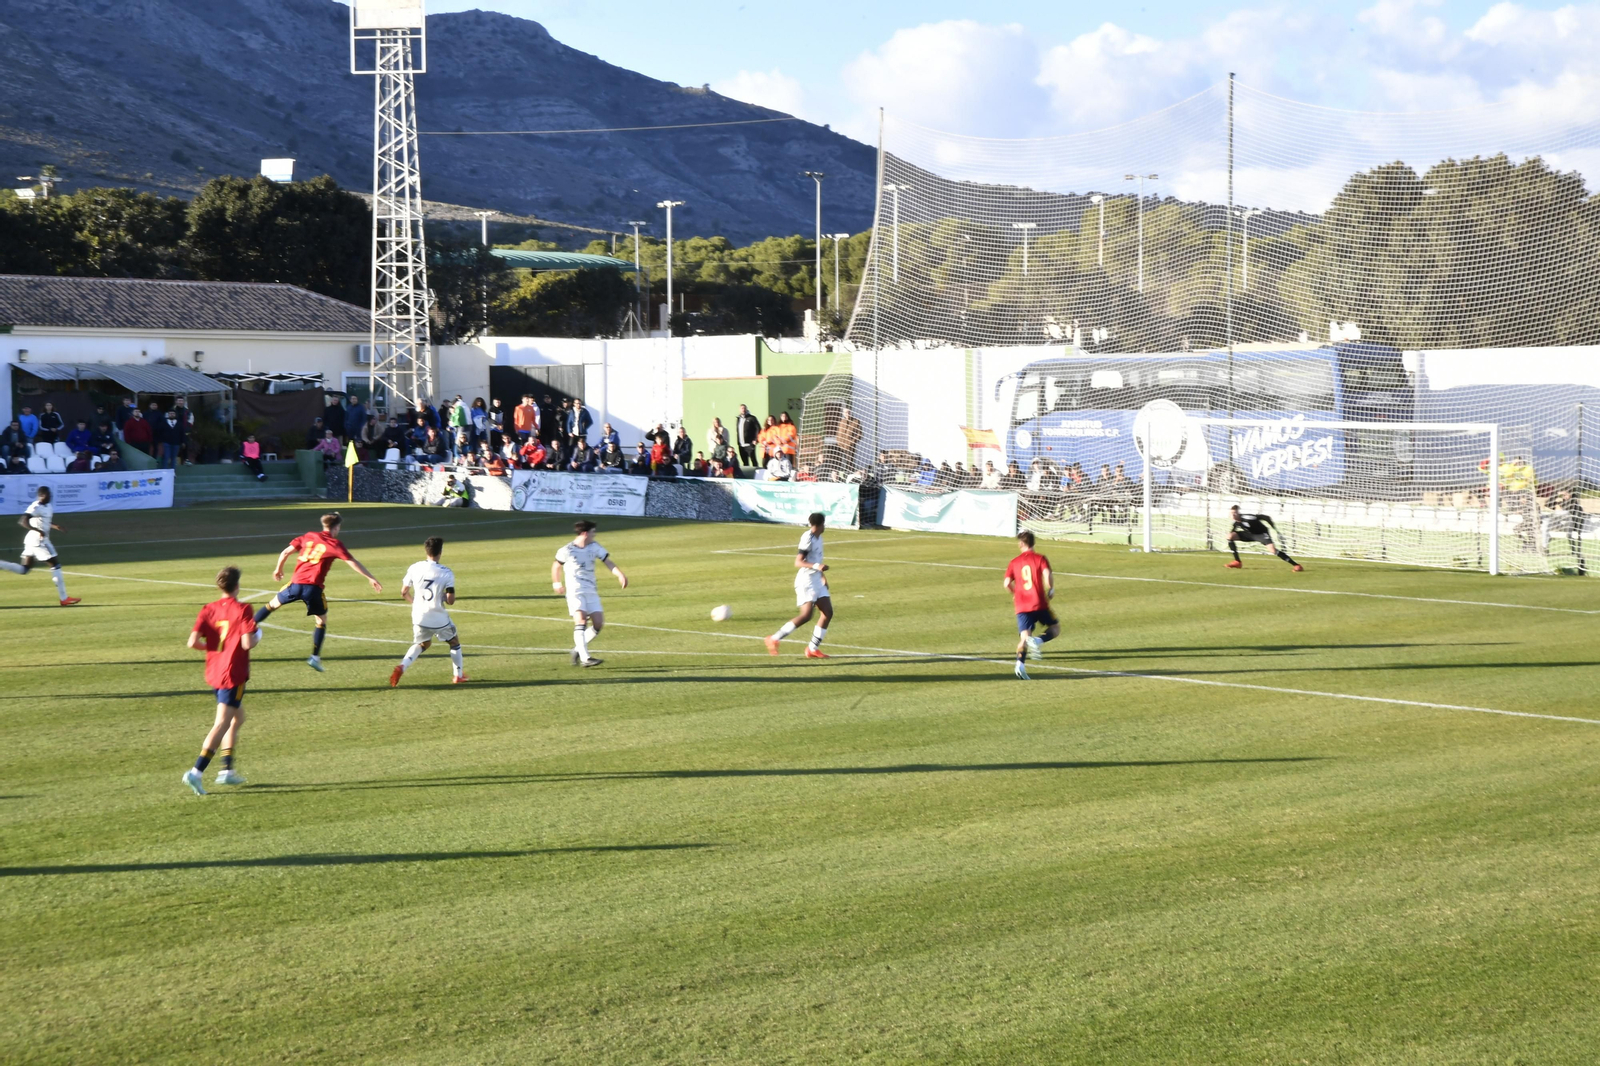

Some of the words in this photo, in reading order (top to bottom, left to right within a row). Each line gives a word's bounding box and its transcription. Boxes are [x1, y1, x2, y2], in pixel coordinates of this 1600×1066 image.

[422, 579, 434, 601] 3
[1021, 565, 1033, 590] 9
[215, 620, 229, 652] 7
